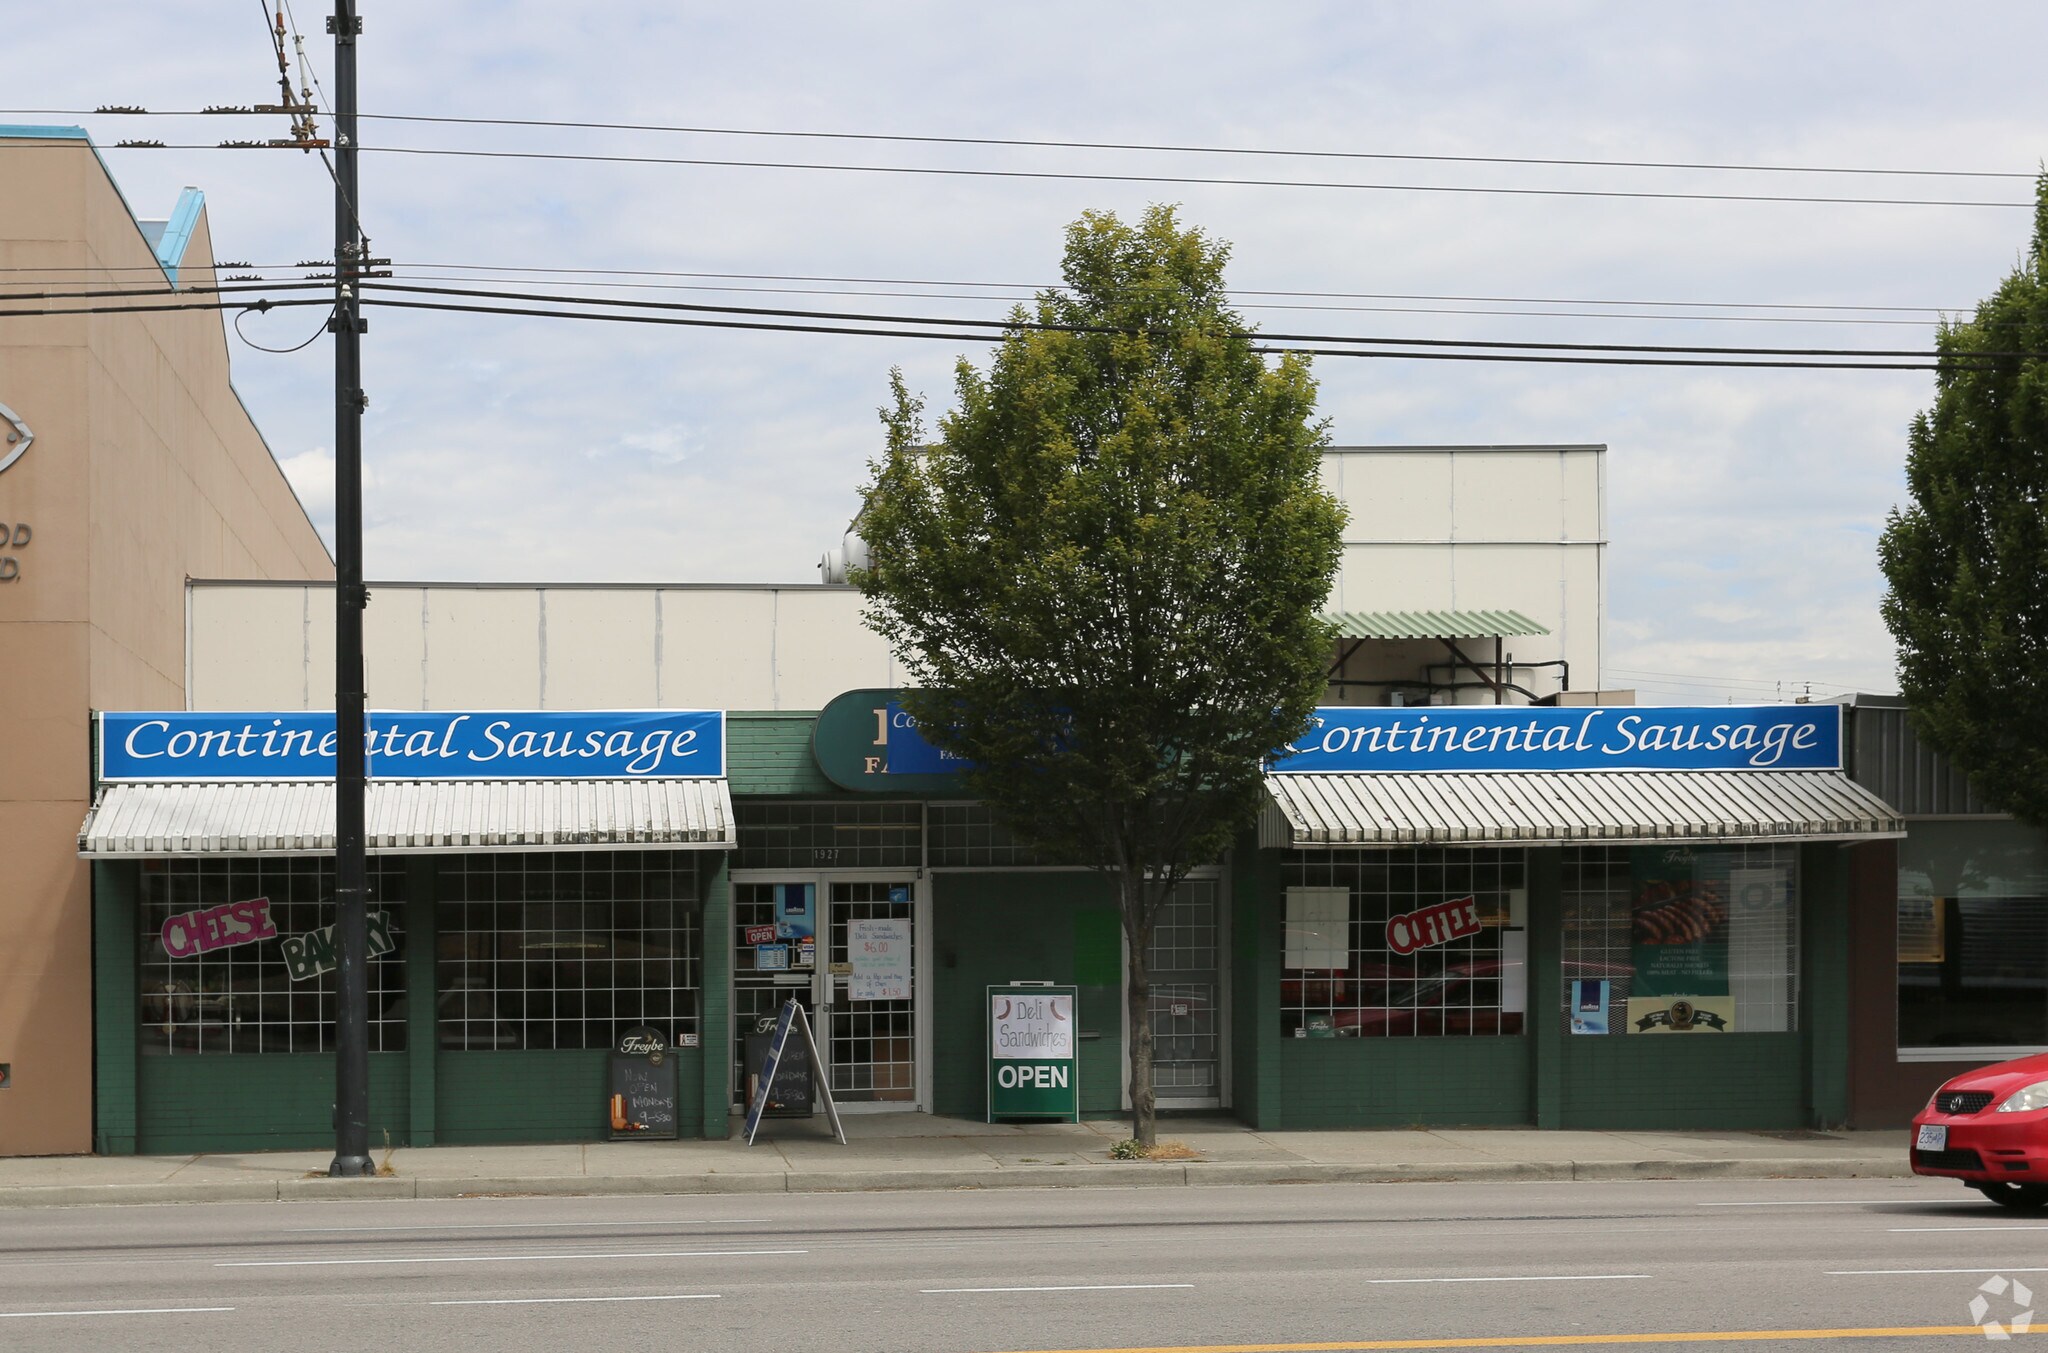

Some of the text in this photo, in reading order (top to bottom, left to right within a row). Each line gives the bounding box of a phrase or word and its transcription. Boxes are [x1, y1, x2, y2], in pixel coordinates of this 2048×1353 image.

[467, 720, 699, 774] Sausage
[1601, 715, 1818, 766] Sausage
[814, 849, 839, 859] 1927
[161, 897, 277, 957] CHEESE
[750, 931, 773, 942] OPEN
[1387, 897, 1480, 954] COFFEE
[1017, 999, 1042, 1020] Deli
[621, 1036, 664, 1055] Freybe
[1000, 1023, 1066, 1052] Sandwiches
[998, 1065, 1068, 1088] OPEN
